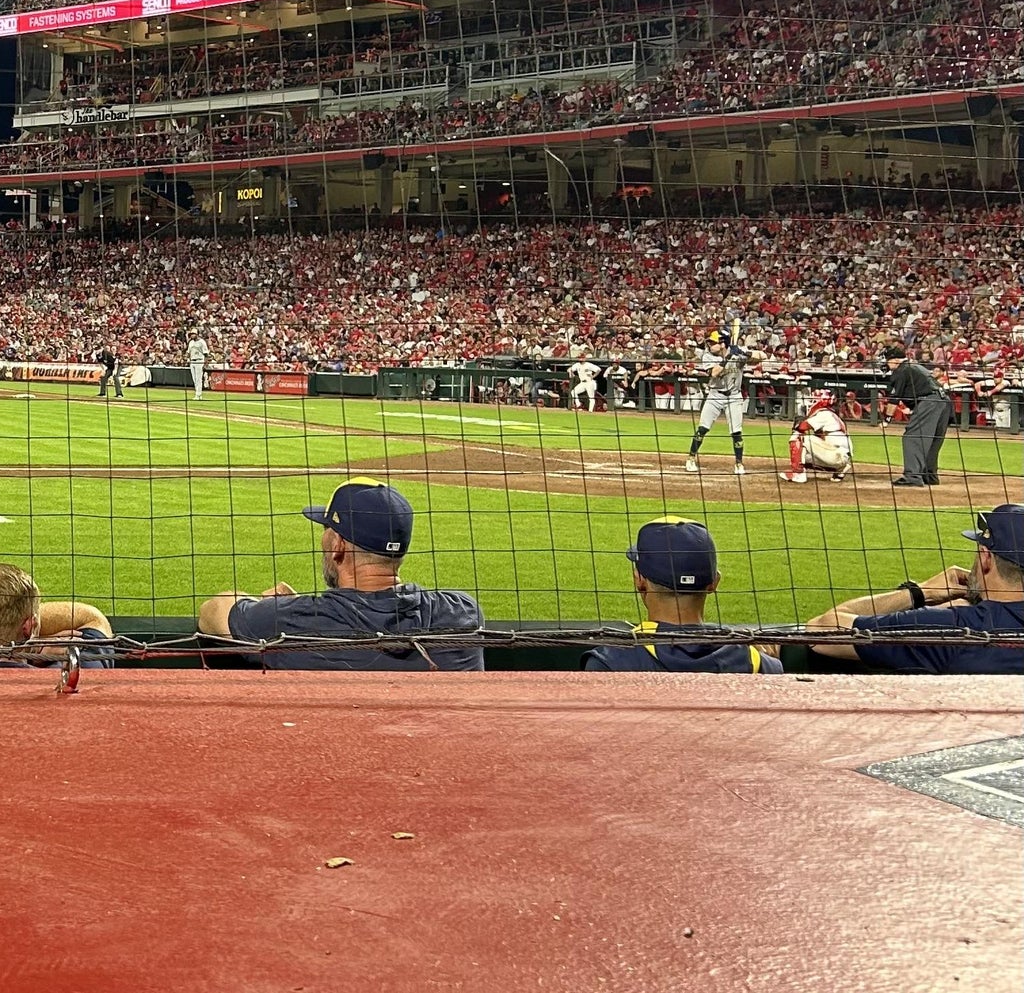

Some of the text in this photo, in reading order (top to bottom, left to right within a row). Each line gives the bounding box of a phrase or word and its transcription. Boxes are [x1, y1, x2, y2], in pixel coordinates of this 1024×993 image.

[29, 11, 75, 27] FASTENING
[76, 6, 116, 20] SYSTEMS
[76, 109, 128, 123] handlebar
[237, 188, 263, 200] KOPOI
